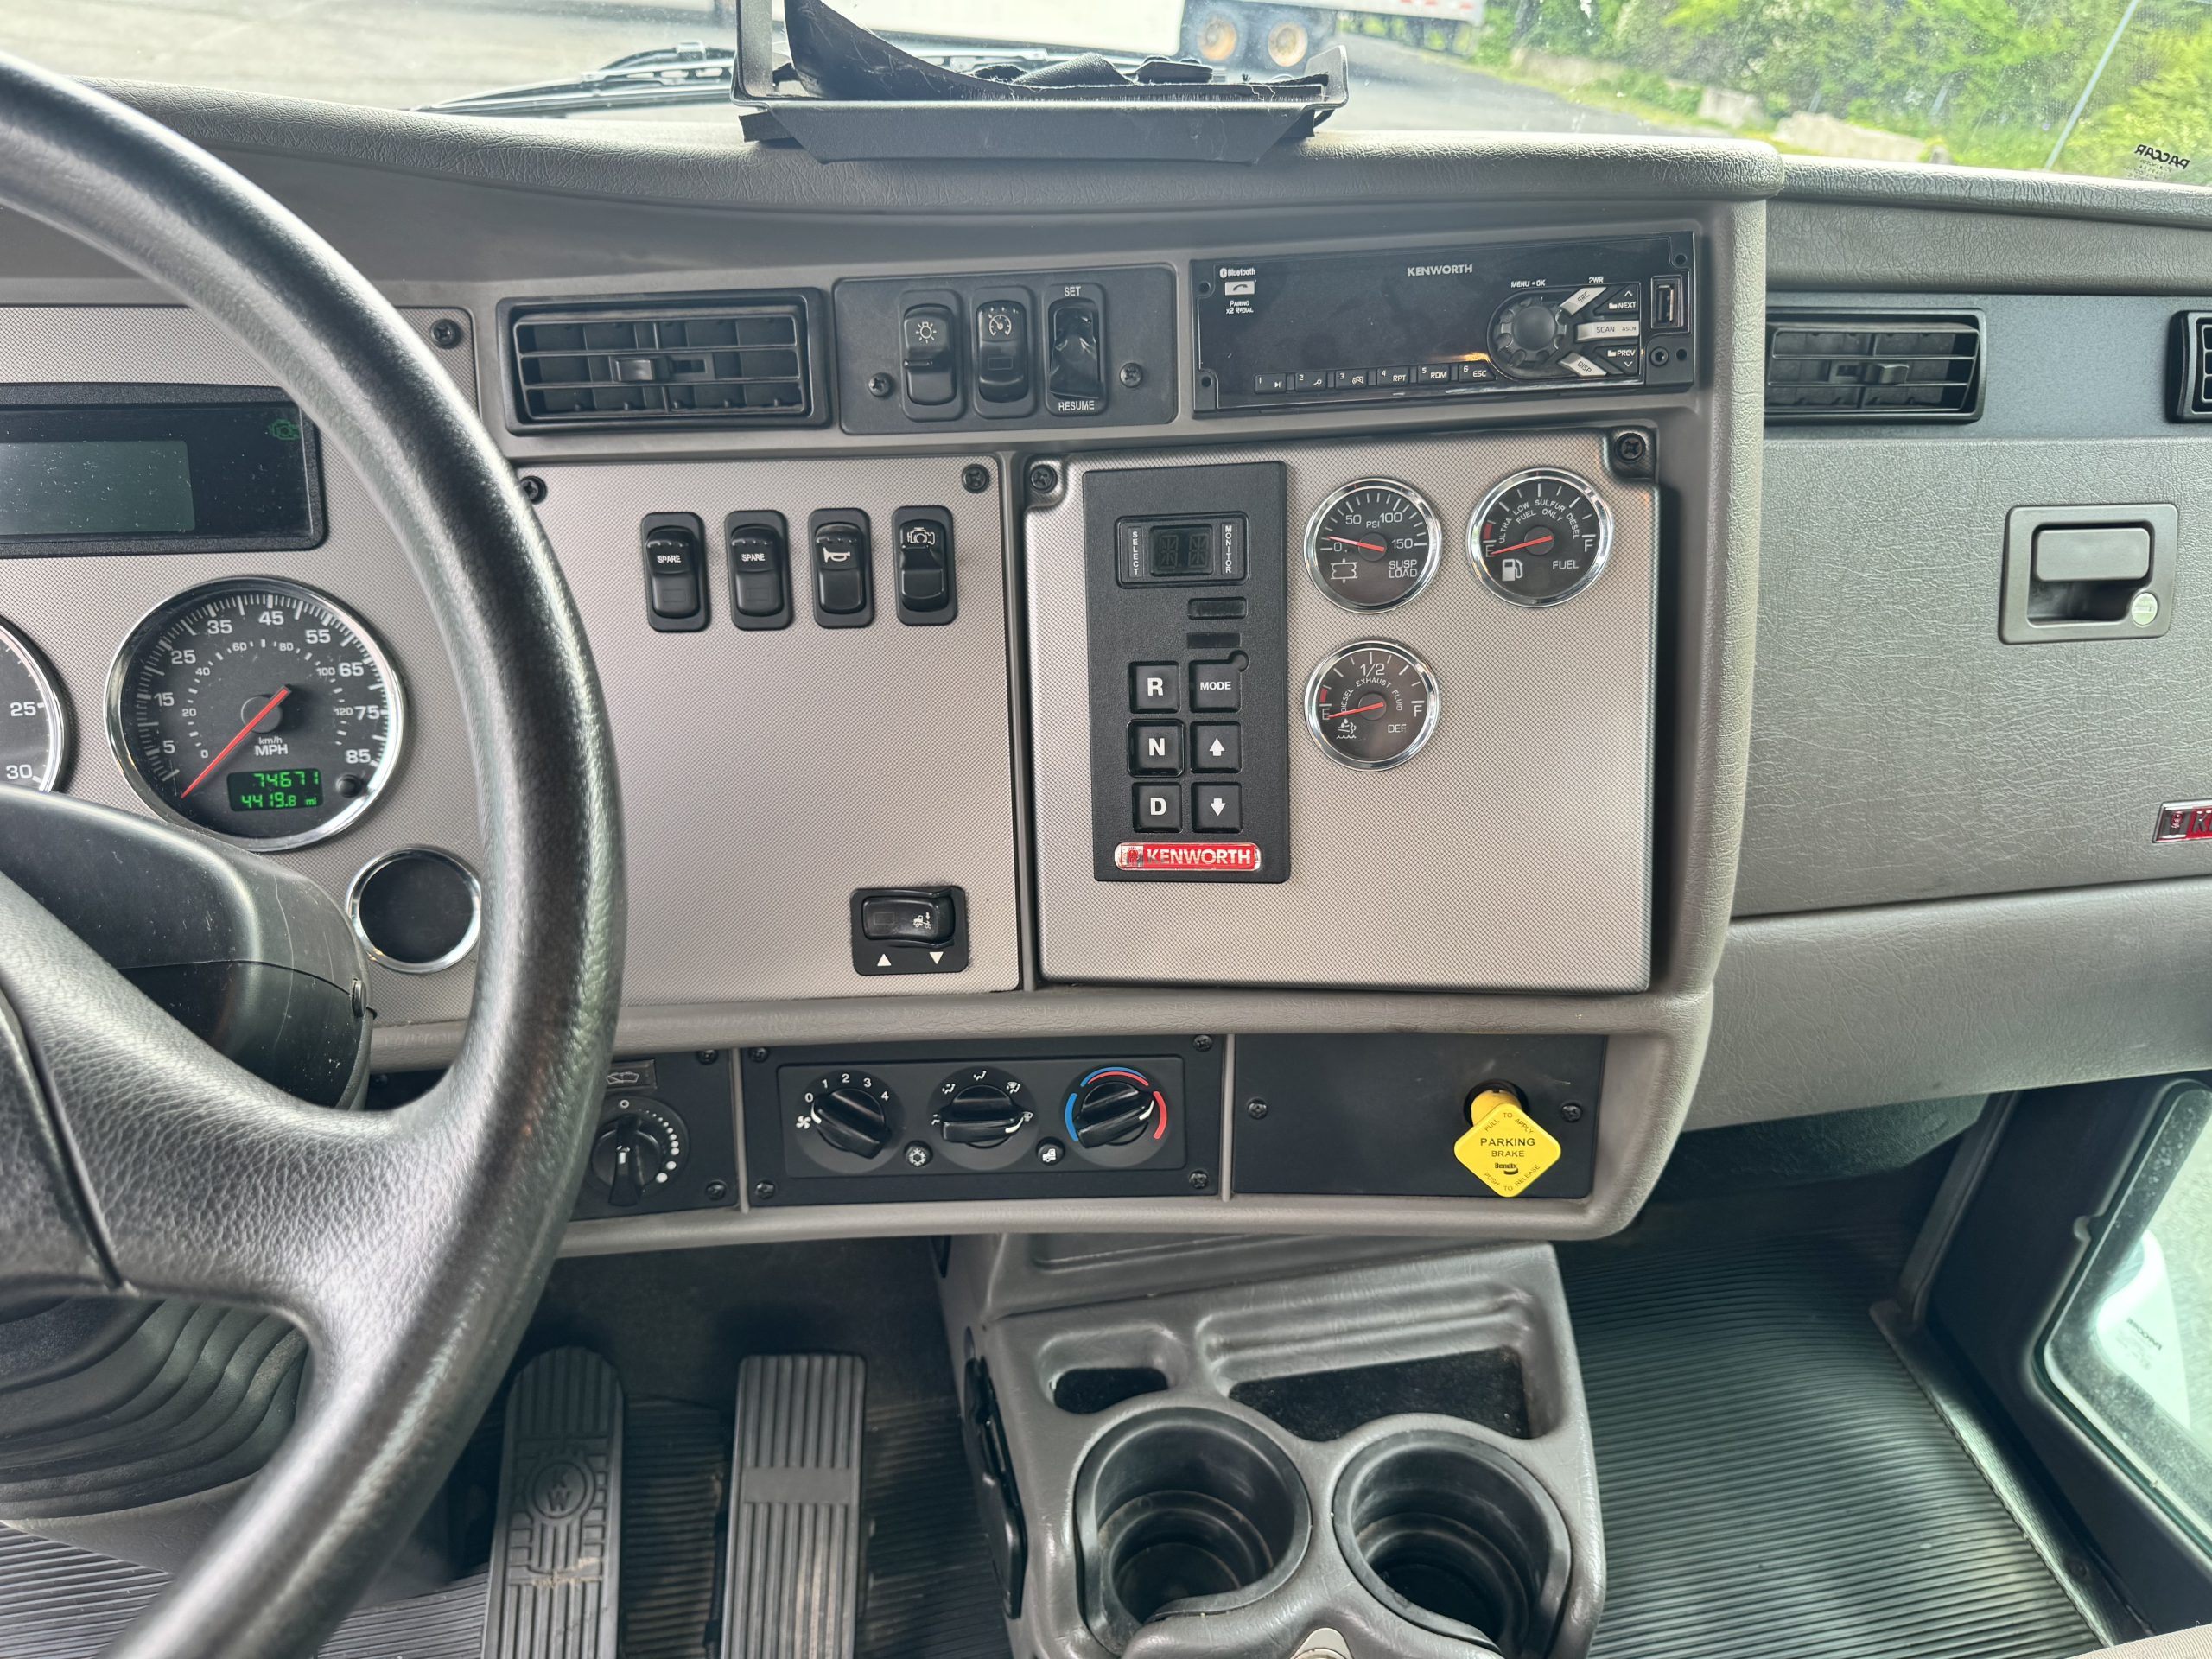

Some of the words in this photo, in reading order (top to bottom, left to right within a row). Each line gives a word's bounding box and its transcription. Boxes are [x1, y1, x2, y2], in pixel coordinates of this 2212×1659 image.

[1227, 268, 1256, 276] Bluetooth
[1407, 264, 1473, 276] KENWORTH
[1064, 286, 1082, 297] SET
[1577, 290, 1591, 303] SRC
[1577, 360, 1592, 373] DISP
[1058, 401, 1095, 412] RESUME
[1345, 514, 1362, 525] 50
[1379, 512, 1403, 524] 100
[1499, 518, 1512, 543] ULTRA
[1512, 502, 1529, 516] LOW
[1535, 499, 1566, 512] SULFUR
[1566, 512, 1580, 540] DIESEL
[1516, 509, 1536, 524] FUEL
[1541, 508, 1564, 522] ONLY
[1366, 520, 1380, 529] PSI
[1333, 542, 1342, 552] 0
[1391, 538, 1414, 550] 150
[1584, 538, 1593, 553] F
[1485, 544, 1495, 558] E
[657, 554, 682, 563] SPARE
[741, 553, 766, 563] SPARE
[1389, 559, 1418, 569] SUSP
[1552, 559, 1580, 570] FUEL
[1389, 569, 1418, 579] LOAD
[258, 610, 284, 626] 45
[207, 619, 232, 635] 35
[305, 629, 331, 645] 55
[232, 642, 247, 652] 60
[279, 642, 294, 652] 80
[171, 649, 196, 664] 25
[195, 666, 210, 676] 40
[315, 667, 335, 677] 100
[339, 662, 364, 677] 65
[1360, 662, 1385, 677] 1/2
[1147, 677, 1164, 696] R
[1199, 681, 1231, 690] MODE
[154, 692, 175, 707] 15
[1340, 688, 1355, 713] DIESEL
[1355, 677, 1392, 688] EXHAUST
[10, 701, 36, 717] 25
[181, 708, 197, 717] 20
[334, 707, 353, 716] 120
[355, 705, 380, 721] 75
[1322, 708, 1331, 721] E
[1414, 704, 1422, 717] F
[1388, 723, 1408, 734] DEF
[259, 735, 283, 745] km/h
[163, 740, 176, 754] 5
[254, 744, 289, 756] MPH
[1148, 738, 1166, 756] N
[200, 749, 209, 759] 0
[346, 748, 371, 764] 85
[6, 764, 33, 779] 30
[253, 771, 319, 788] 74671
[242, 792, 296, 809] 4419.8
[305, 797, 317, 806] mi
[1150, 798, 1167, 816] D
[1147, 849, 1251, 865] KENWORTH
[822, 1079, 828, 1089] 1
[842, 1073, 850, 1083] 2
[863, 1077, 872, 1088] 3
[804, 1092, 814, 1103] 0
[880, 1090, 889, 1101] 4
[1484, 1118, 1500, 1132] PULL
[1514, 1117, 1535, 1135] APPLY
[1479, 1137, 1535, 1147] PARKING
[1484, 1172, 1500, 1186] PUSH
[1515, 1164, 1541, 1186] RELEASE
